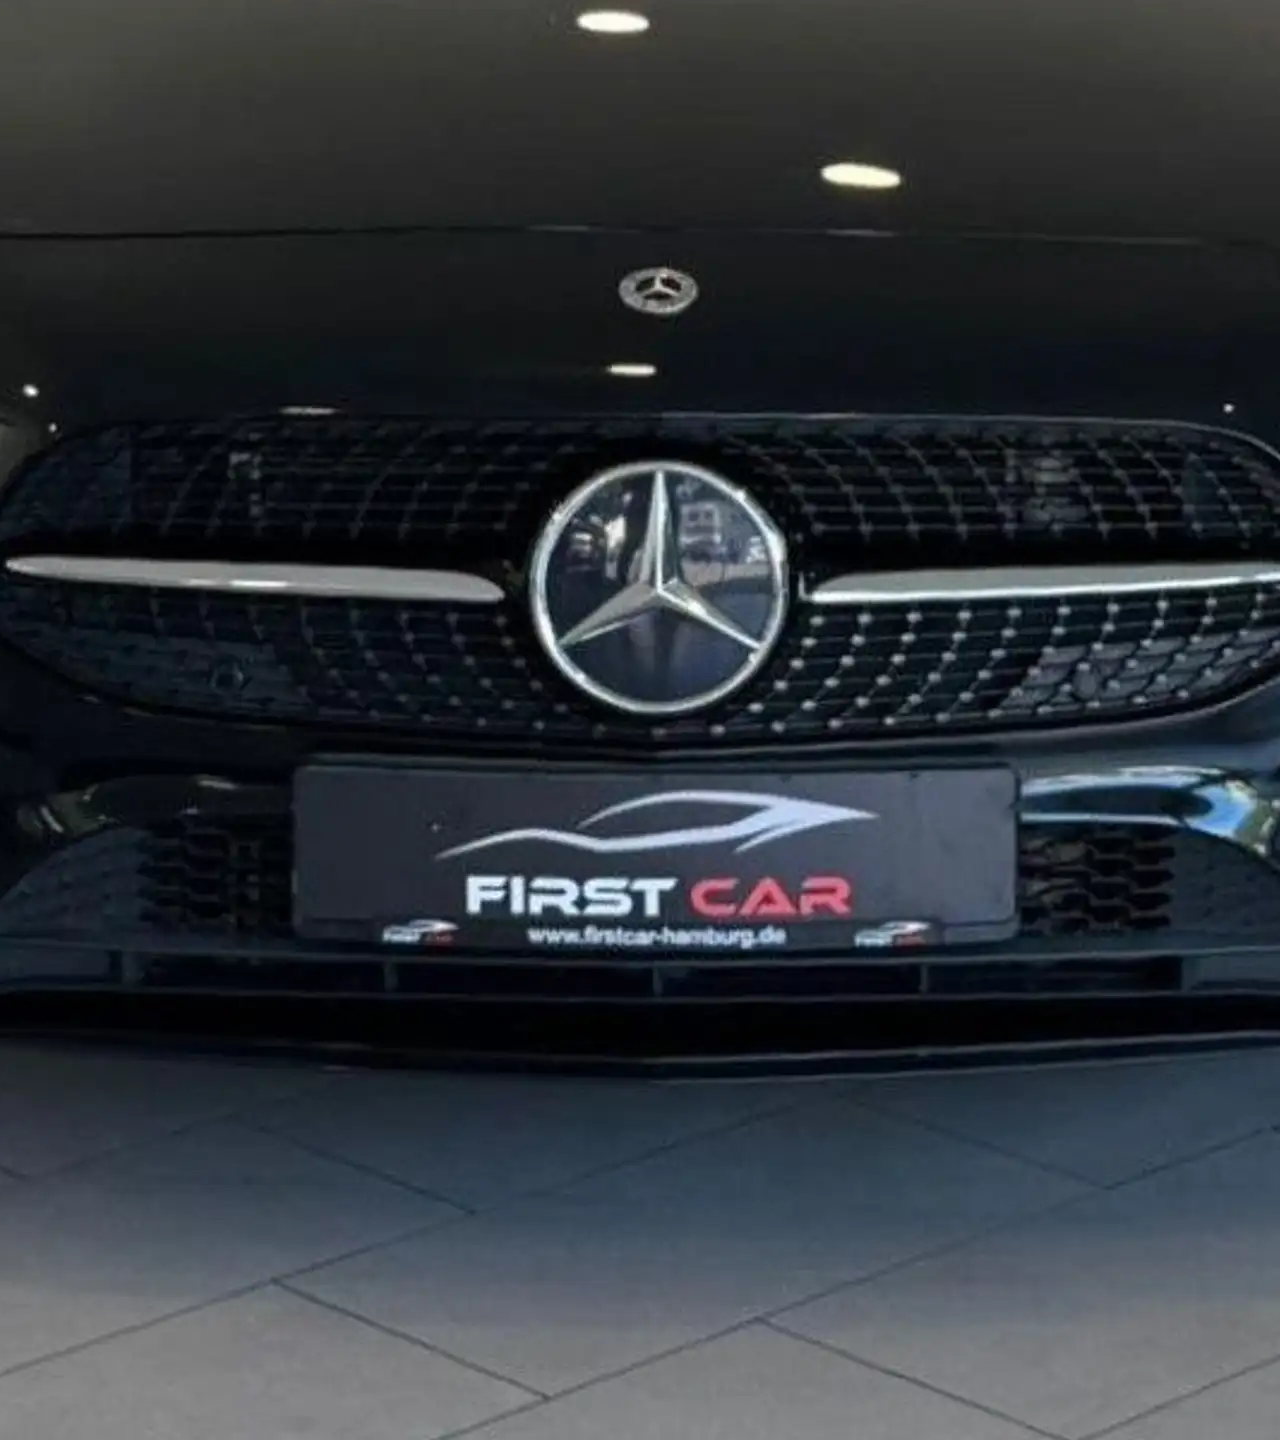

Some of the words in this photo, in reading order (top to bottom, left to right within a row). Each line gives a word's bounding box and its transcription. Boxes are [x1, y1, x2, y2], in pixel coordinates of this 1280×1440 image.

[466, 875, 678, 917] FIRST
[690, 876, 852, 917] CAR
[527, 924, 787, 949] www.firstcar-hamburg.de
